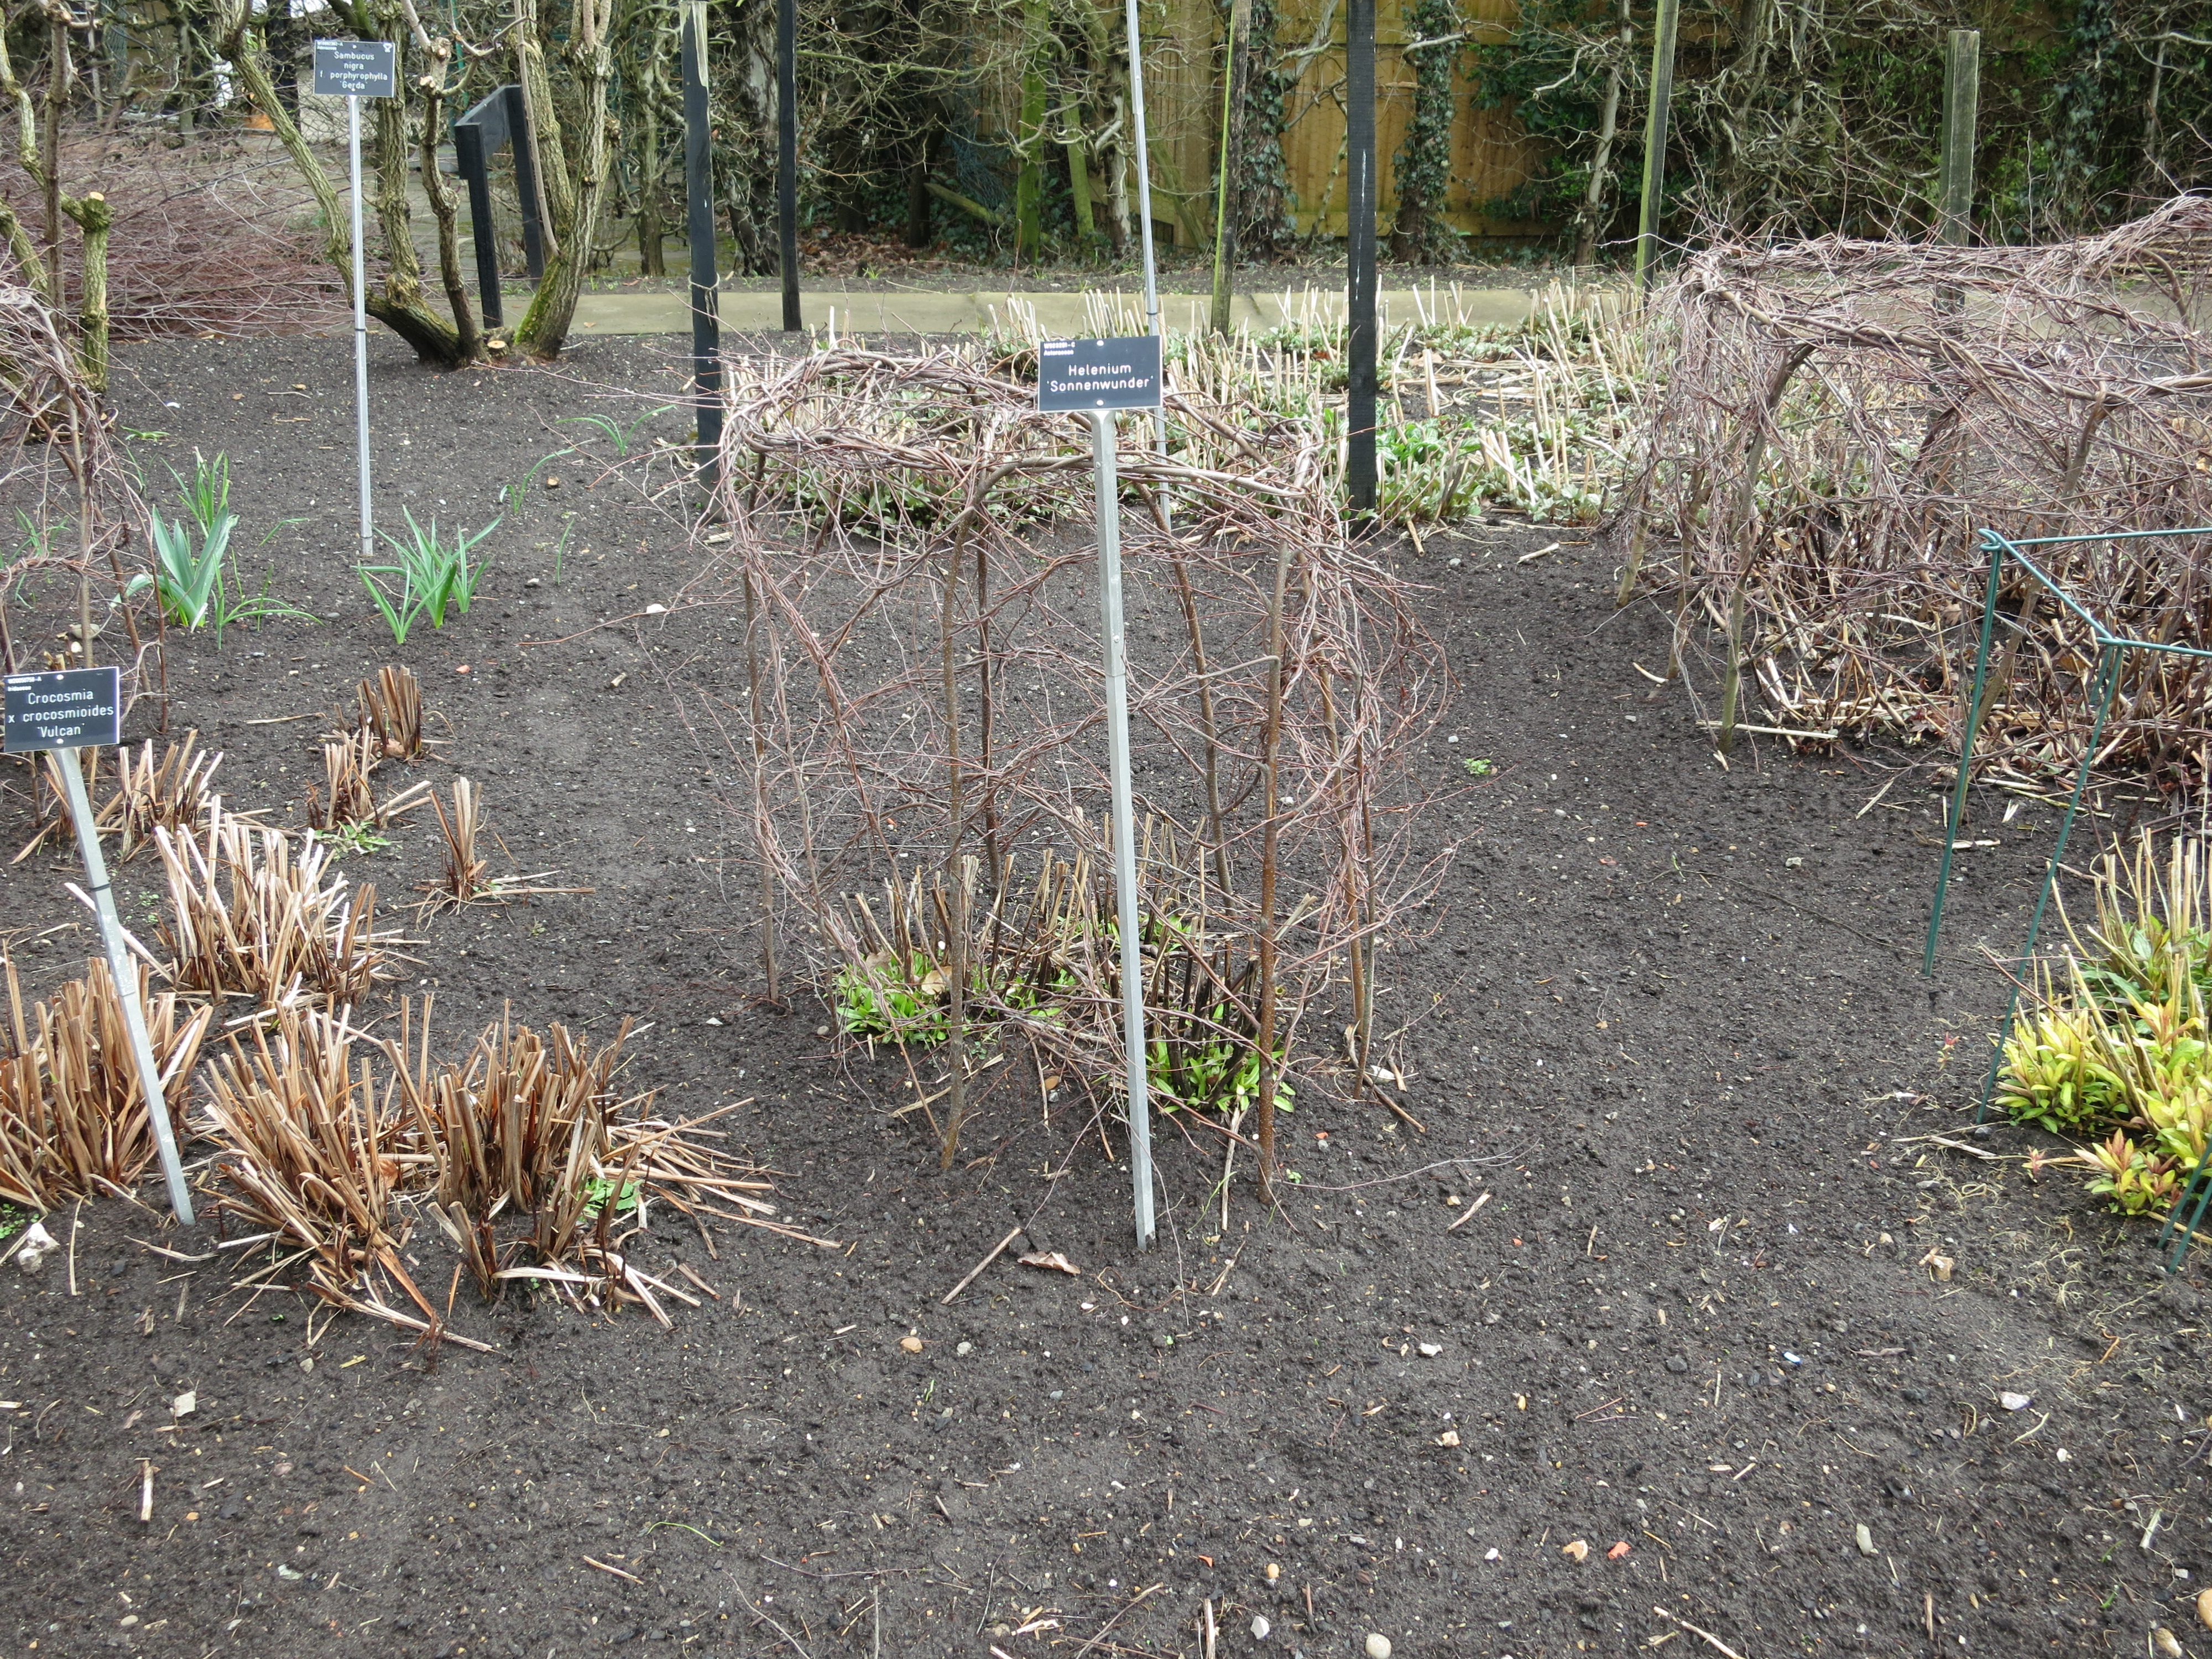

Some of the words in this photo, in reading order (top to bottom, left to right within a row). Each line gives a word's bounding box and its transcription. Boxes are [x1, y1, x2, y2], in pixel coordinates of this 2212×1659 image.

[334, 51, 375, 60] Sambucus
[344, 61, 364, 71] nigra
[330, 71, 388, 82] porphyrophylla
[1068, 363, 1131, 376] Helenium
[28, 688, 94, 705] Crocosmia
[8, 714, 15, 723] x
[23, 705, 114, 722] crocosmioides
